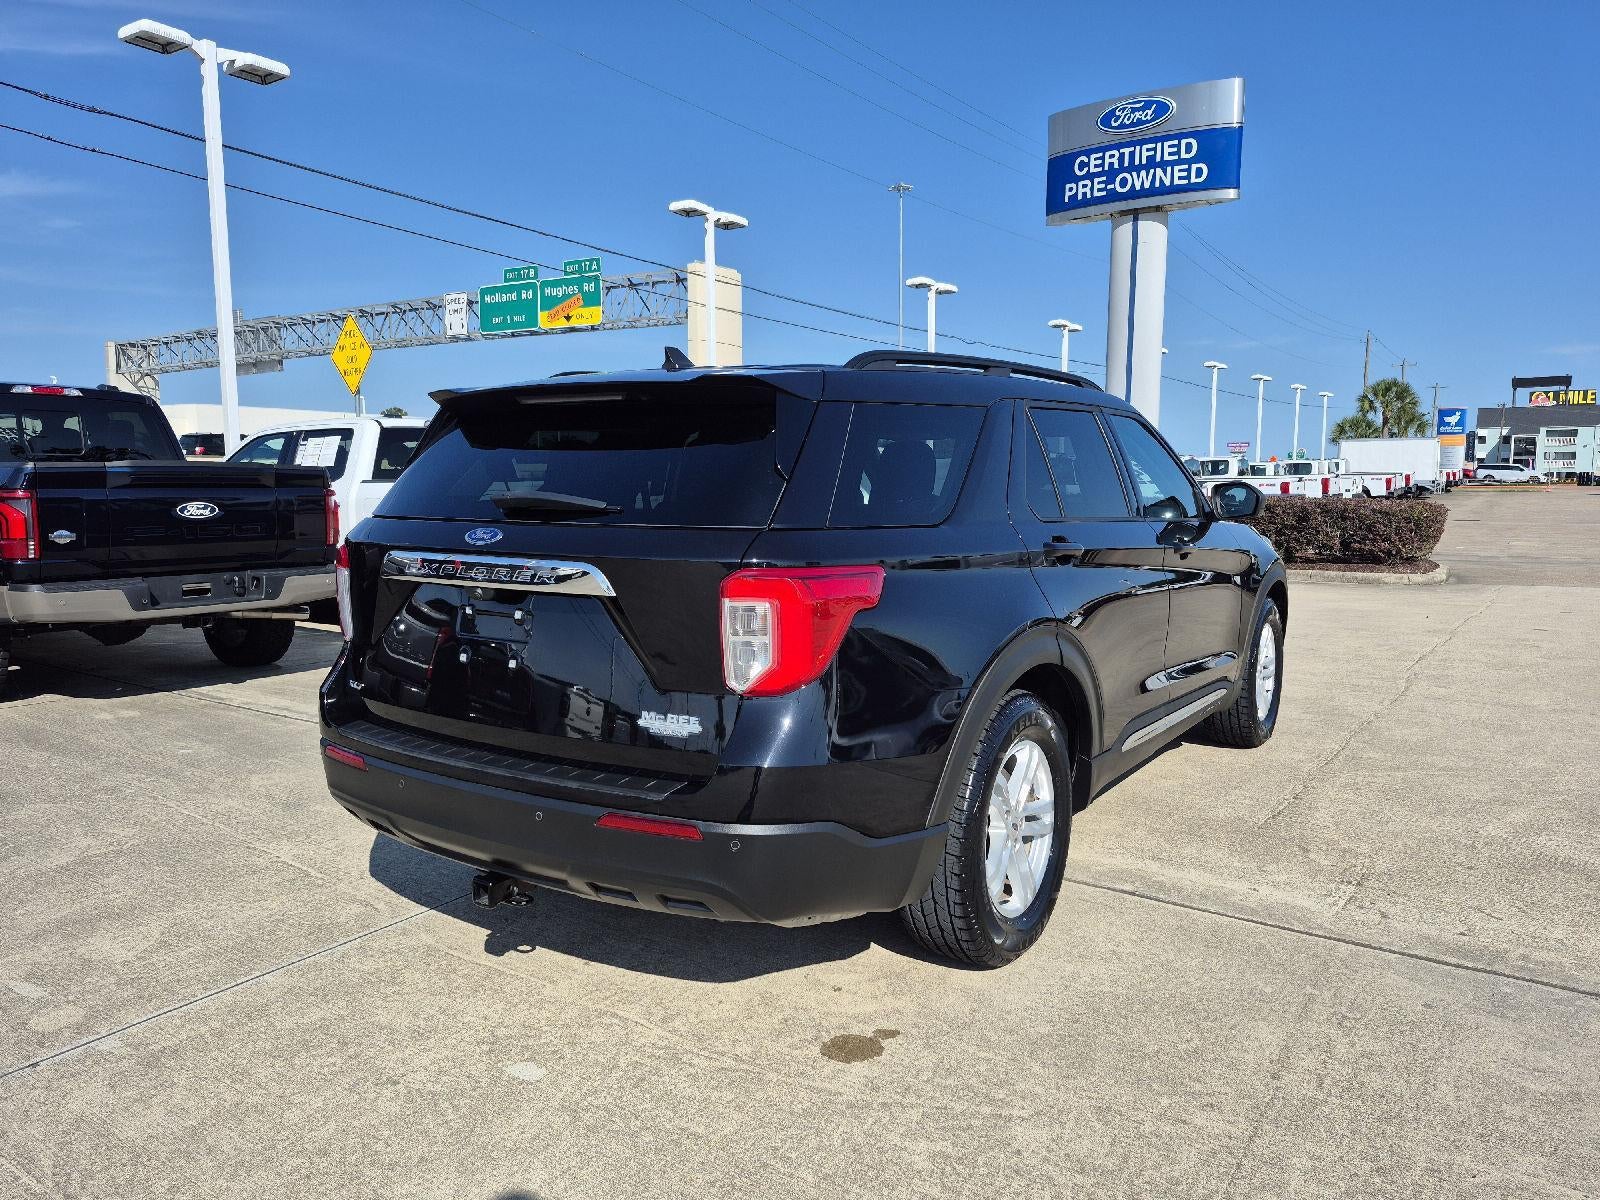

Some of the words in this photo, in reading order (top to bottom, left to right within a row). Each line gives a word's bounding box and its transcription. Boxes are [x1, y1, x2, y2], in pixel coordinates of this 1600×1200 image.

[1110, 101, 1157, 127] Ford
[1073, 137, 1198, 176] CERTIFIED
[1064, 163, 1209, 203] PRE-OWNED
[566, 264, 579, 272] EXIT
[581, 261, 590, 271] 17
[591, 260, 598, 270] A
[506, 270, 518, 279] EXIT
[484, 291, 517, 304] Holland
[521, 288, 533, 300] Rd
[544, 284, 579, 298] Hughes
[583, 282, 595, 293] Rd
[446, 297, 465, 306] SPEED
[448, 307, 463, 316] LIMIT
[575, 311, 594, 320] ONLY
[492, 316, 504, 325] EXIT
[506, 315, 511, 324] 1
[513, 314, 526, 323] MILE
[1559, 389, 1597, 405] MILE
[184, 504, 212, 518] Ford
[405, 562, 556, 584] EXPLORER
